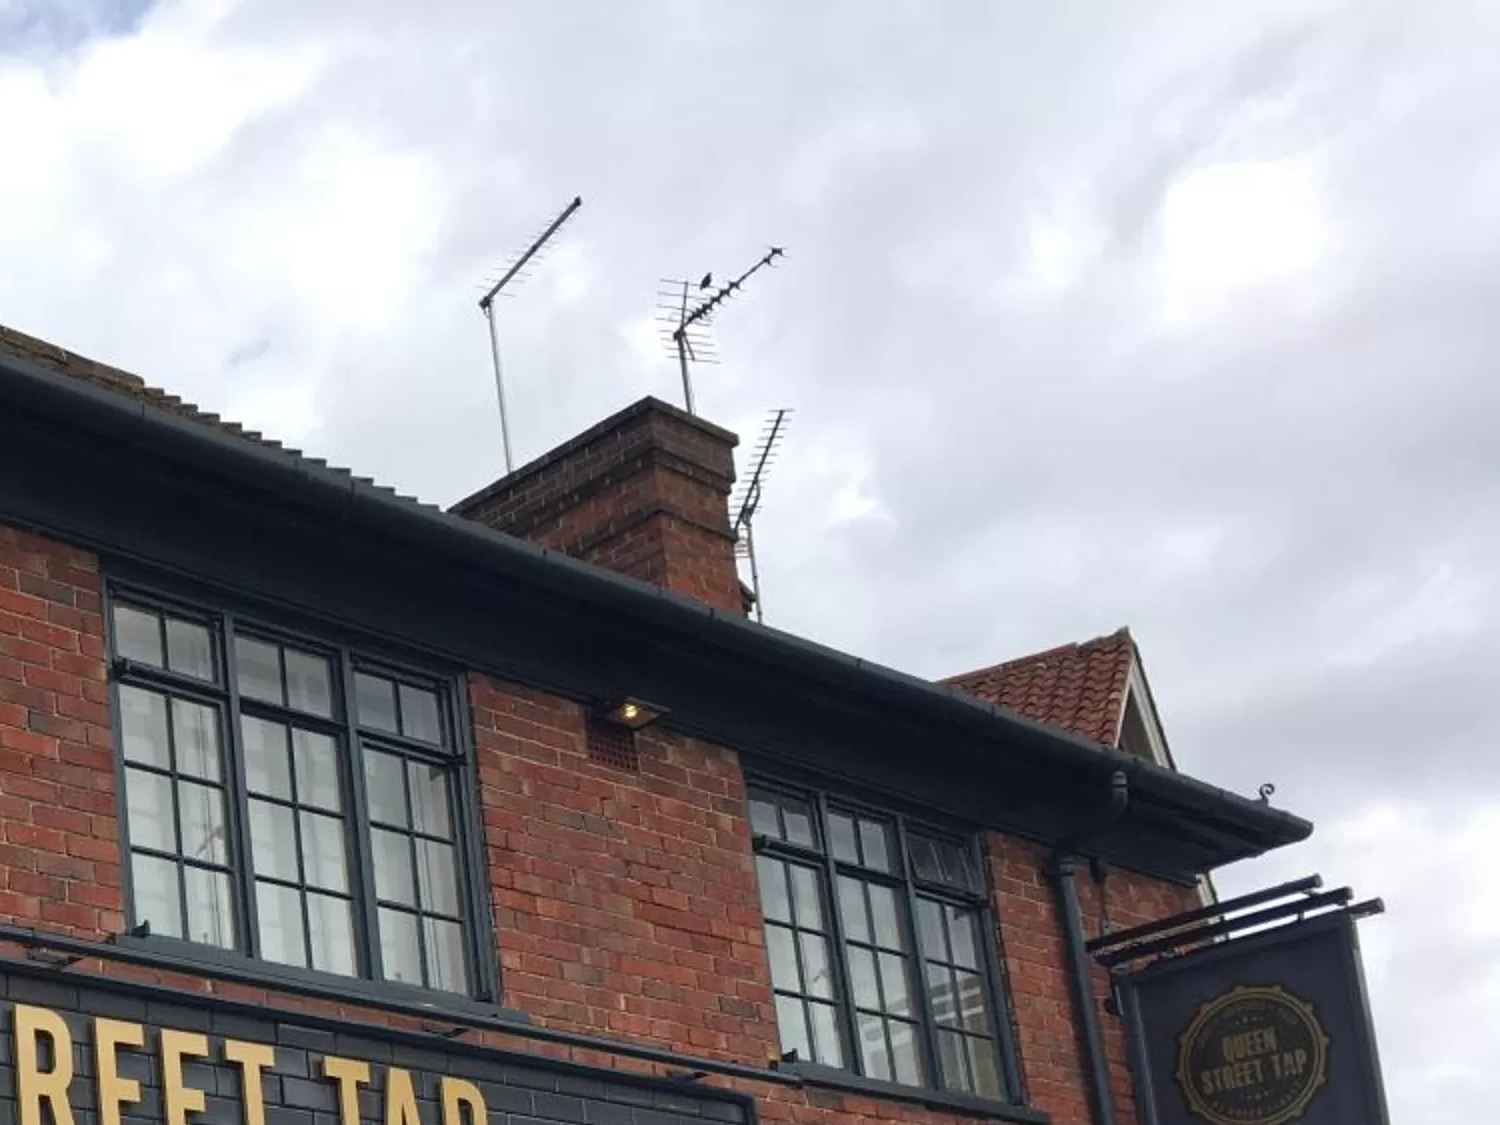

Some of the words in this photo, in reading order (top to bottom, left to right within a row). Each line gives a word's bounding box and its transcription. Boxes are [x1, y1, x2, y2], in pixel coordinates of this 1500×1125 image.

[1221, 1026, 1278, 1062] QUEEN
[1200, 1058, 1264, 1095] STREET
[1270, 1048, 1308, 1081] TAP
